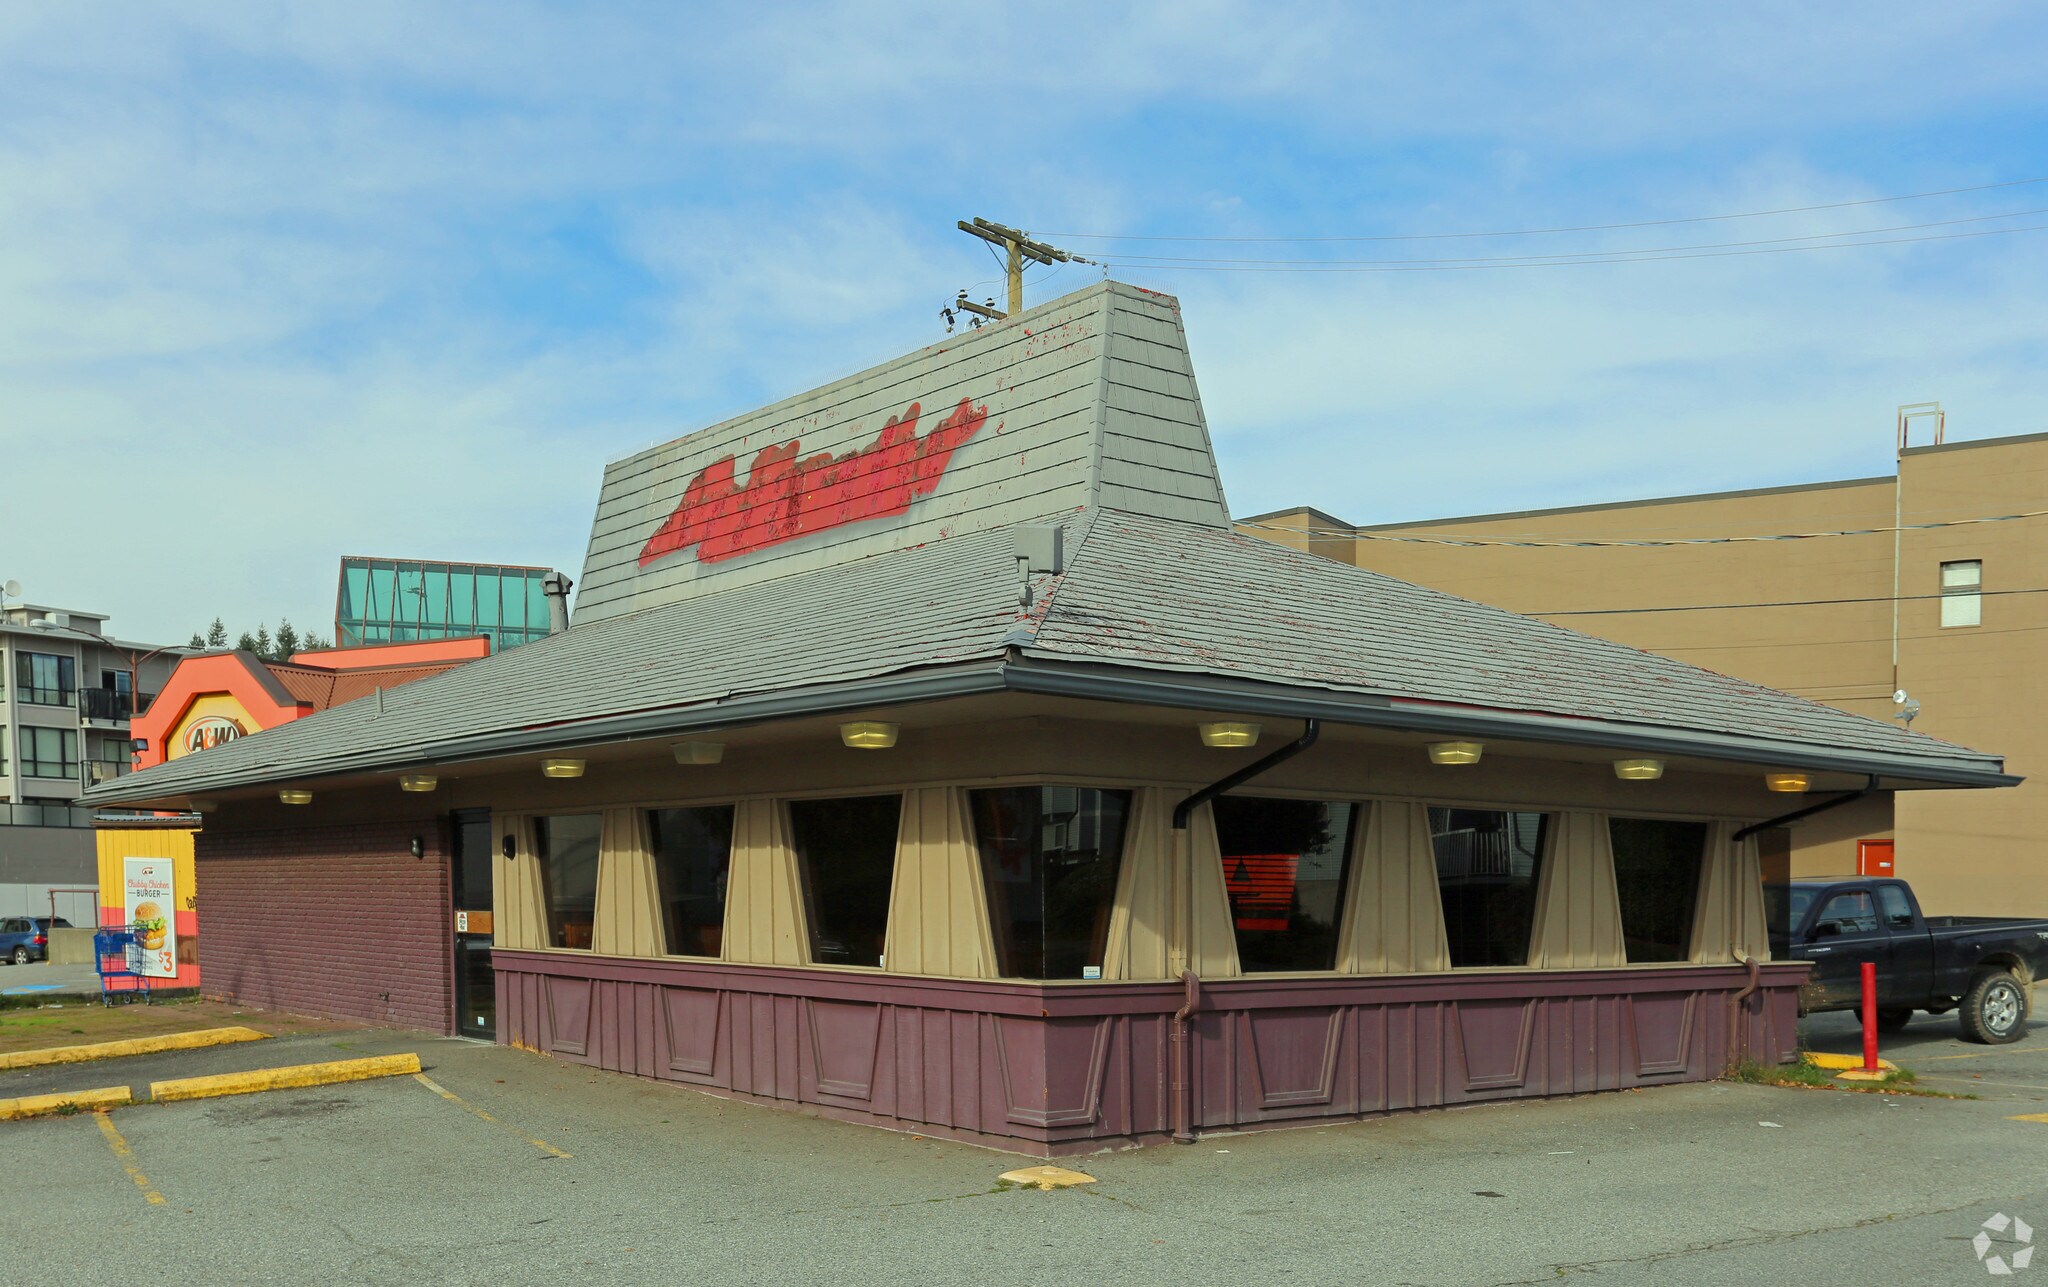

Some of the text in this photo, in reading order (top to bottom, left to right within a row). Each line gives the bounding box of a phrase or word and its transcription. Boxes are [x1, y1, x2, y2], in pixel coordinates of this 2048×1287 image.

[192, 726, 238, 751] A&W
[128, 879, 169, 889] Chubby Chicken
[136, 889, 161, 898] BURGER
[158, 949, 173, 973] $3
